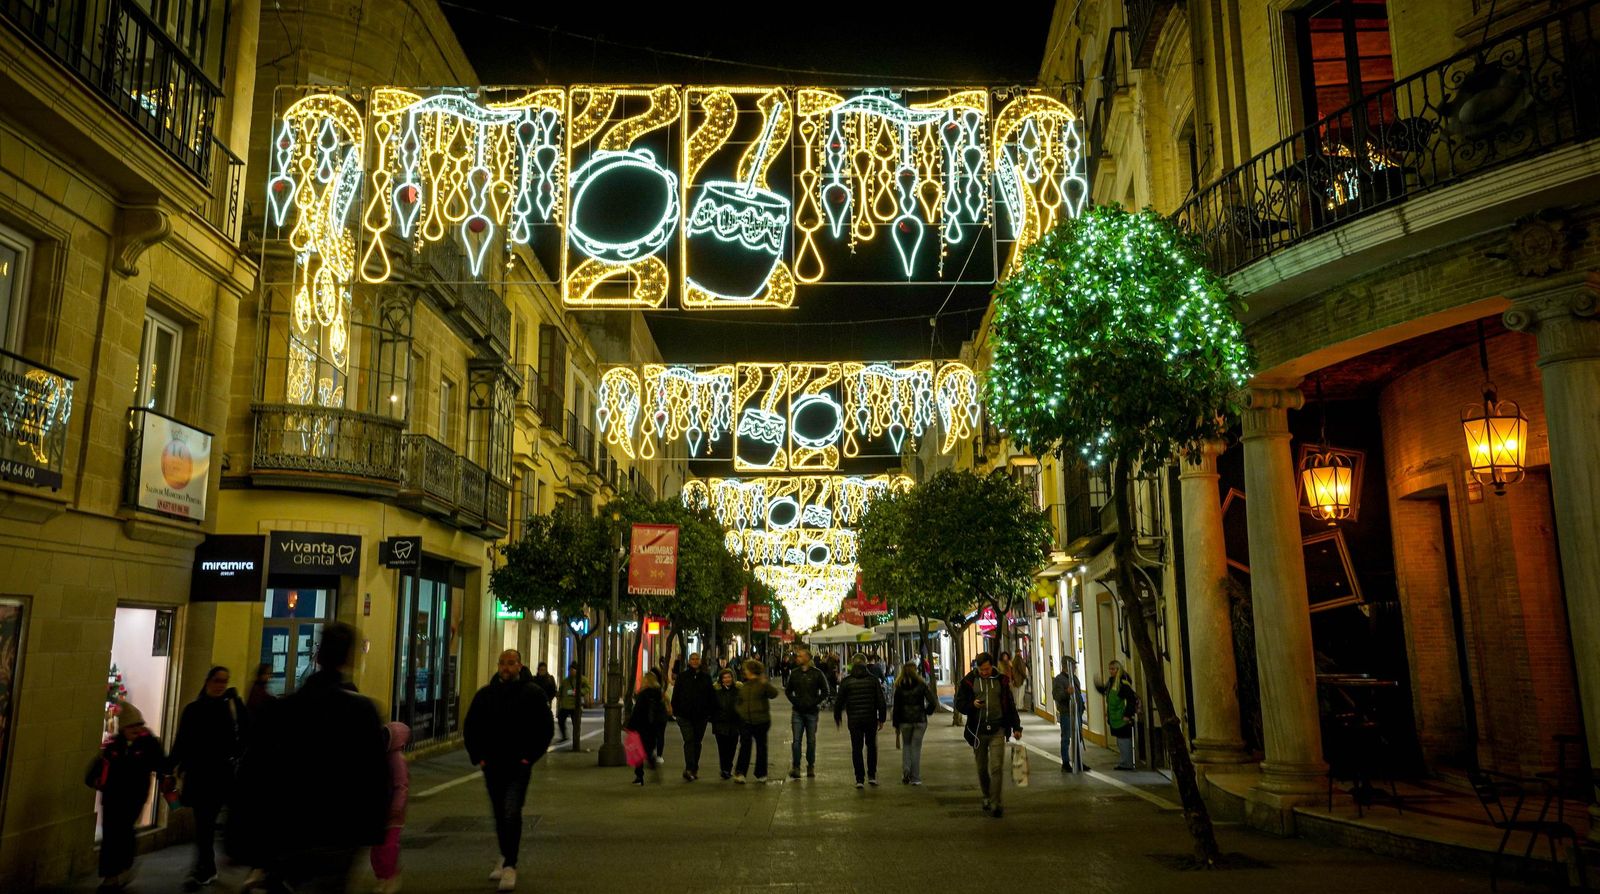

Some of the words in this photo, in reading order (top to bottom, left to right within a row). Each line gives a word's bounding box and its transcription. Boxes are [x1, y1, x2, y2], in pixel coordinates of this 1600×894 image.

[0, 460, 11, 474] 64
[13, 463, 23, 476] 64
[25, 466, 35, 479] 60
[281, 540, 335, 554] vivanta
[293, 553, 335, 565] dental
[202, 561, 254, 571] miramira
[628, 585, 676, 597] Cruzcampo
